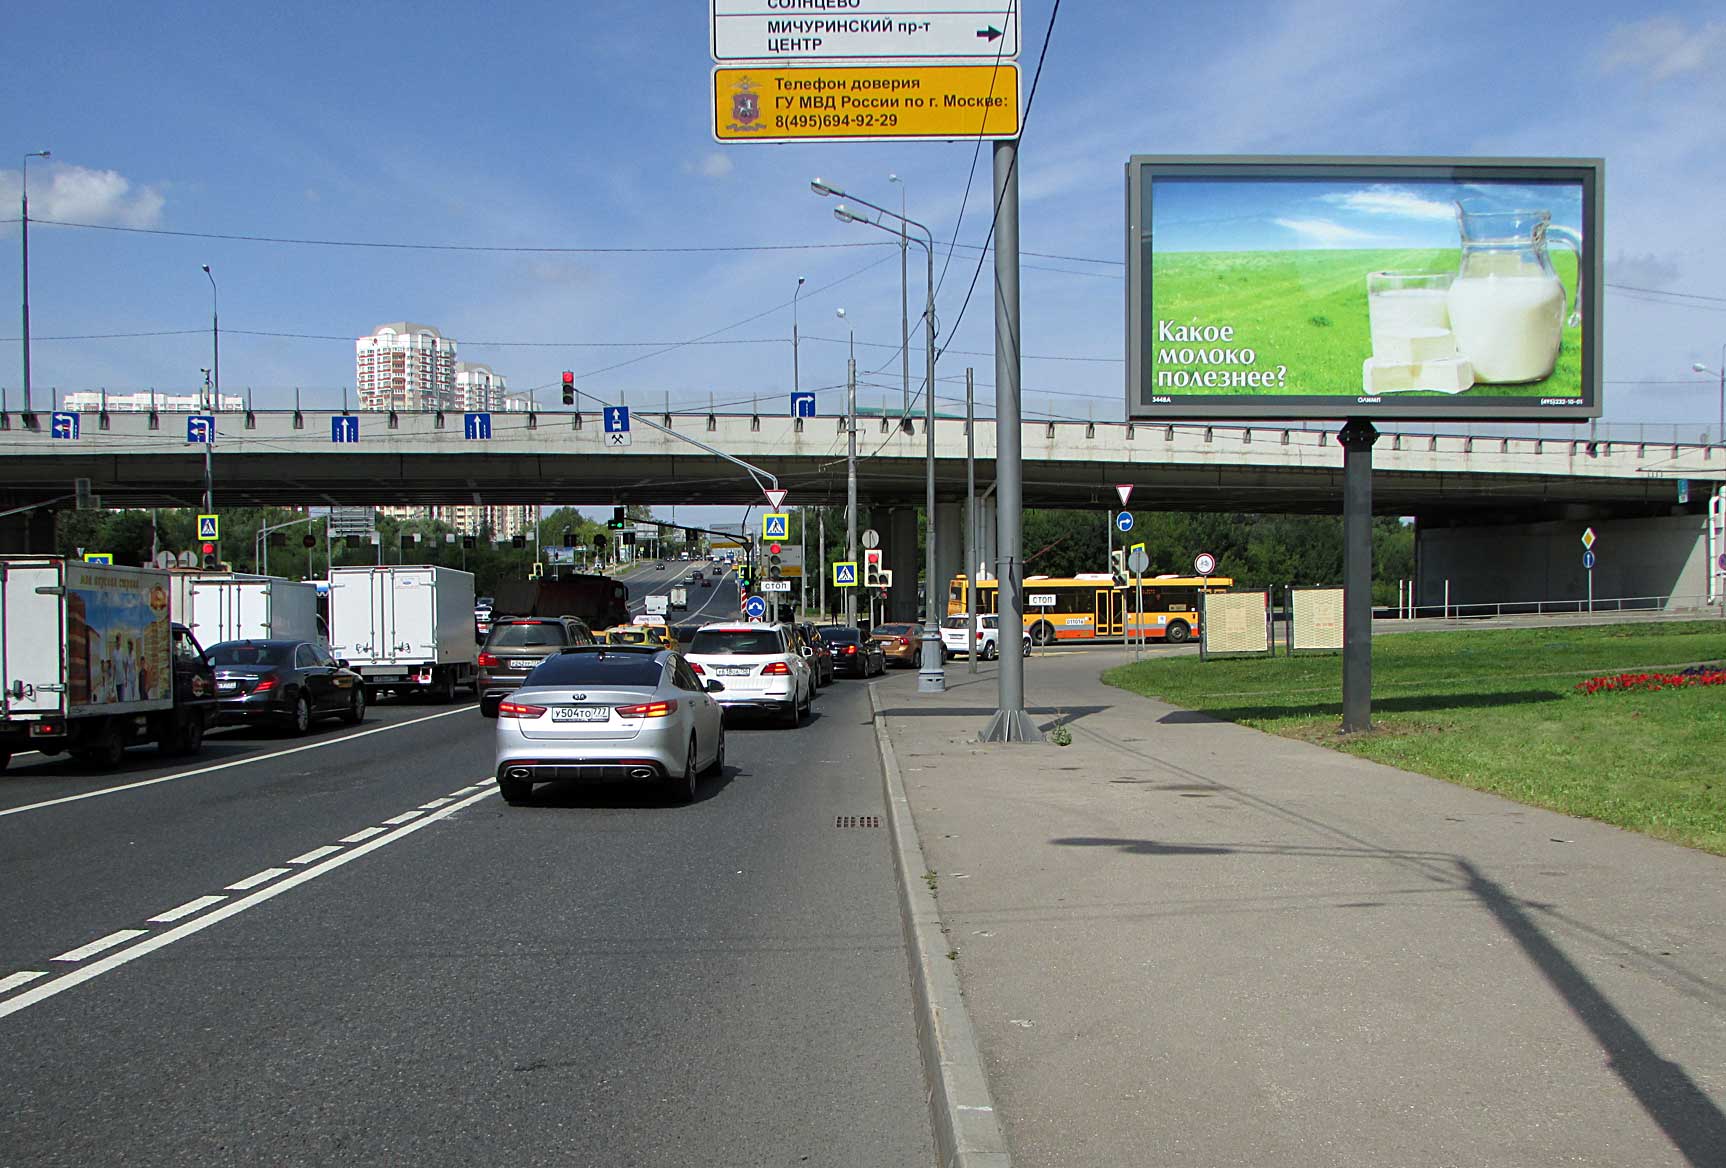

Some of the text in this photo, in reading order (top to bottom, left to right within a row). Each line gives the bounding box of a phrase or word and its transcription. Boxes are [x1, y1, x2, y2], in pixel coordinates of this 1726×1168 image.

[767, 0, 860, 10] СОЛНЦЕВО
[767, 17, 931, 35] МИЧУРИНСКИЙ пр-т
[768, 38, 822, 53] ЦЕНТР
[775, 77, 920, 92] Телефон доверия
[775, 94, 1008, 110] ГУ МВД России по г. Москве:
[775, 113, 898, 130] 8(495)694-92-29
[1158, 319, 1234, 342] Какое
[1157, 348, 1256, 365] молоко
[1158, 365, 1287, 387] полезнее?
[1032, 596, 1053, 604] СТОП
